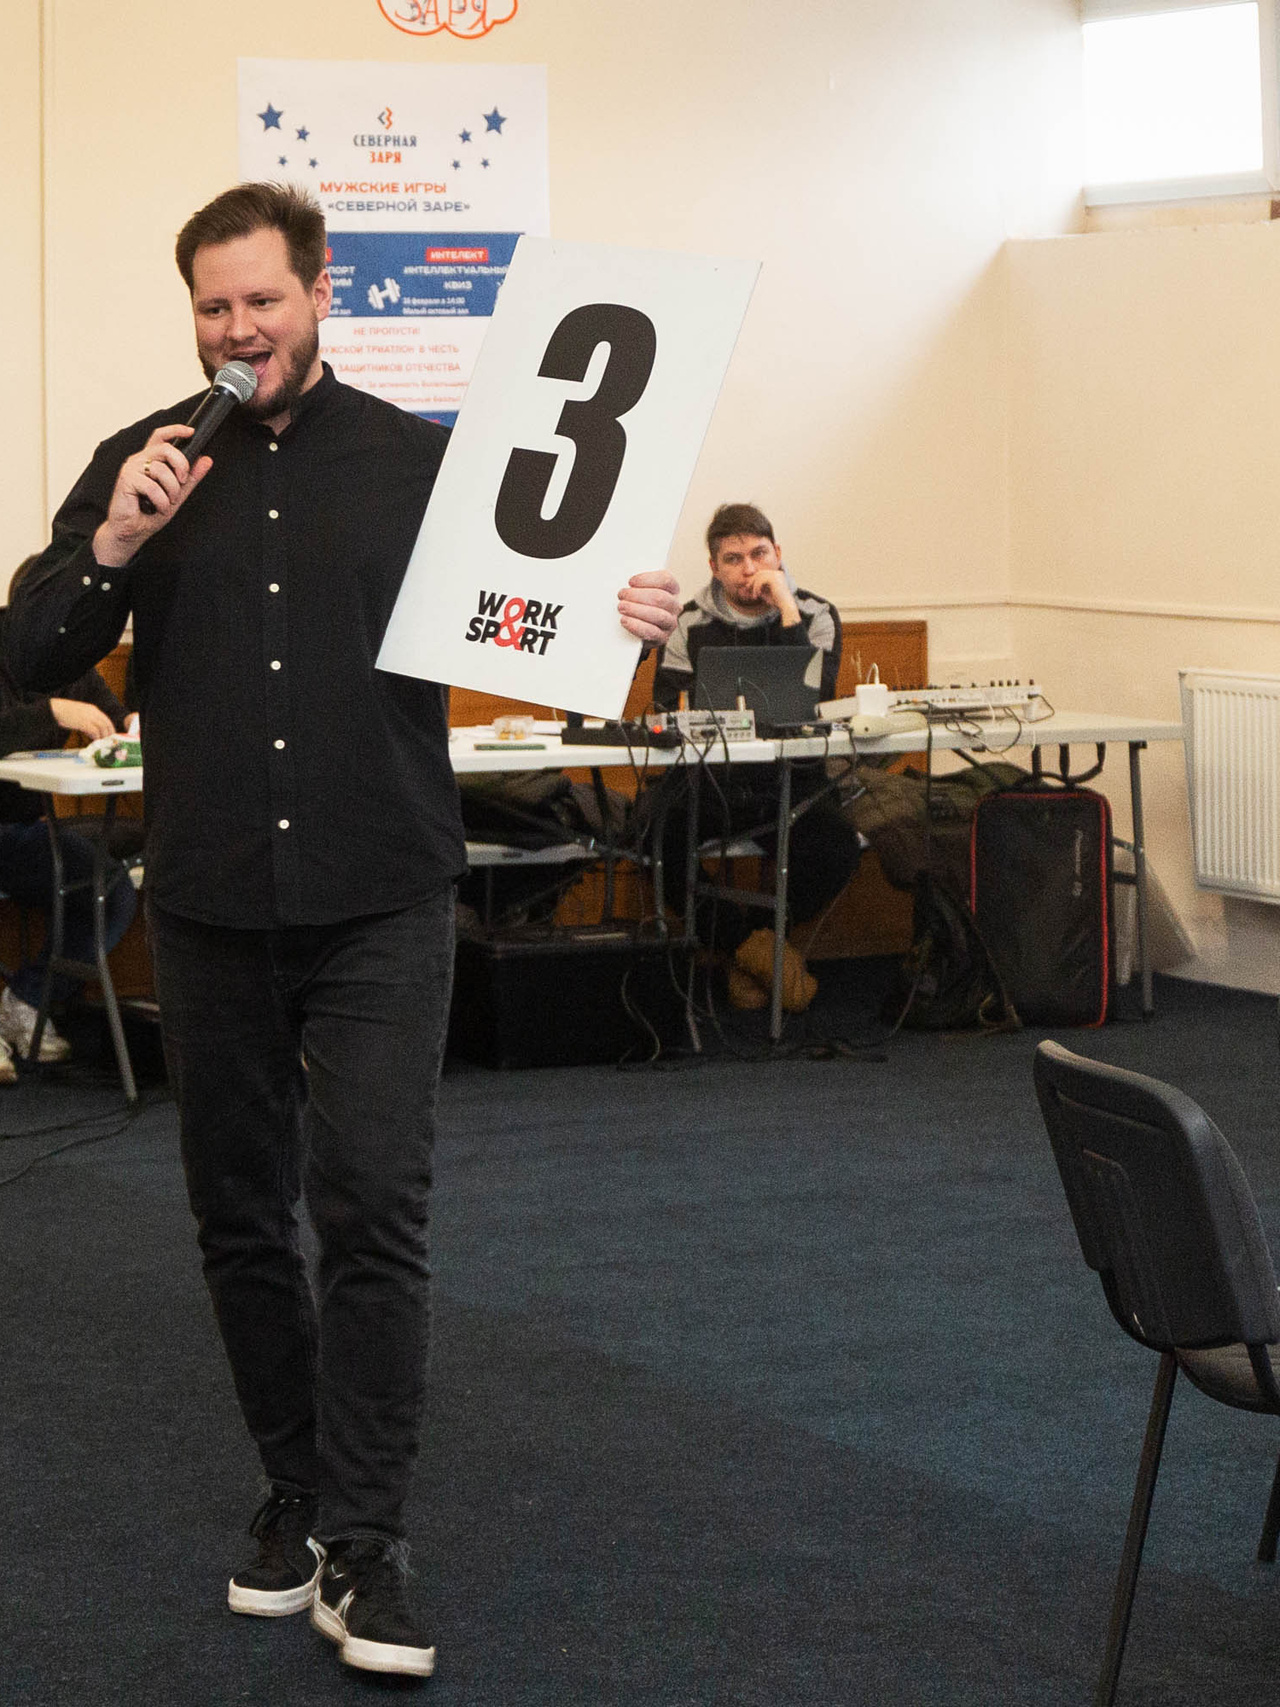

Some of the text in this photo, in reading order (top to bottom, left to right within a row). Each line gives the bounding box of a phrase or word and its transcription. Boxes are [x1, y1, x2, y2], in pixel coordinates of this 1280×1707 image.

[353, 135, 418, 148] СЕВЕРНАЯ
[369, 151, 402, 164] ЗАРЯ
[320, 181, 447, 194] МУЖСКИЕ ИГРЫ
[327, 199, 471, 213] «СЕВЕРНОЙ ЗАРЕ»
[430, 250, 485, 260] ИНТЕЛЕКТ
[353, 327, 366, 336] НЕ
[429, 345, 460, 354] ЧЕСТЬ
[405, 363, 462, 372] ОТЕЧЕСТВА
[494, 303, 658, 560] 3
